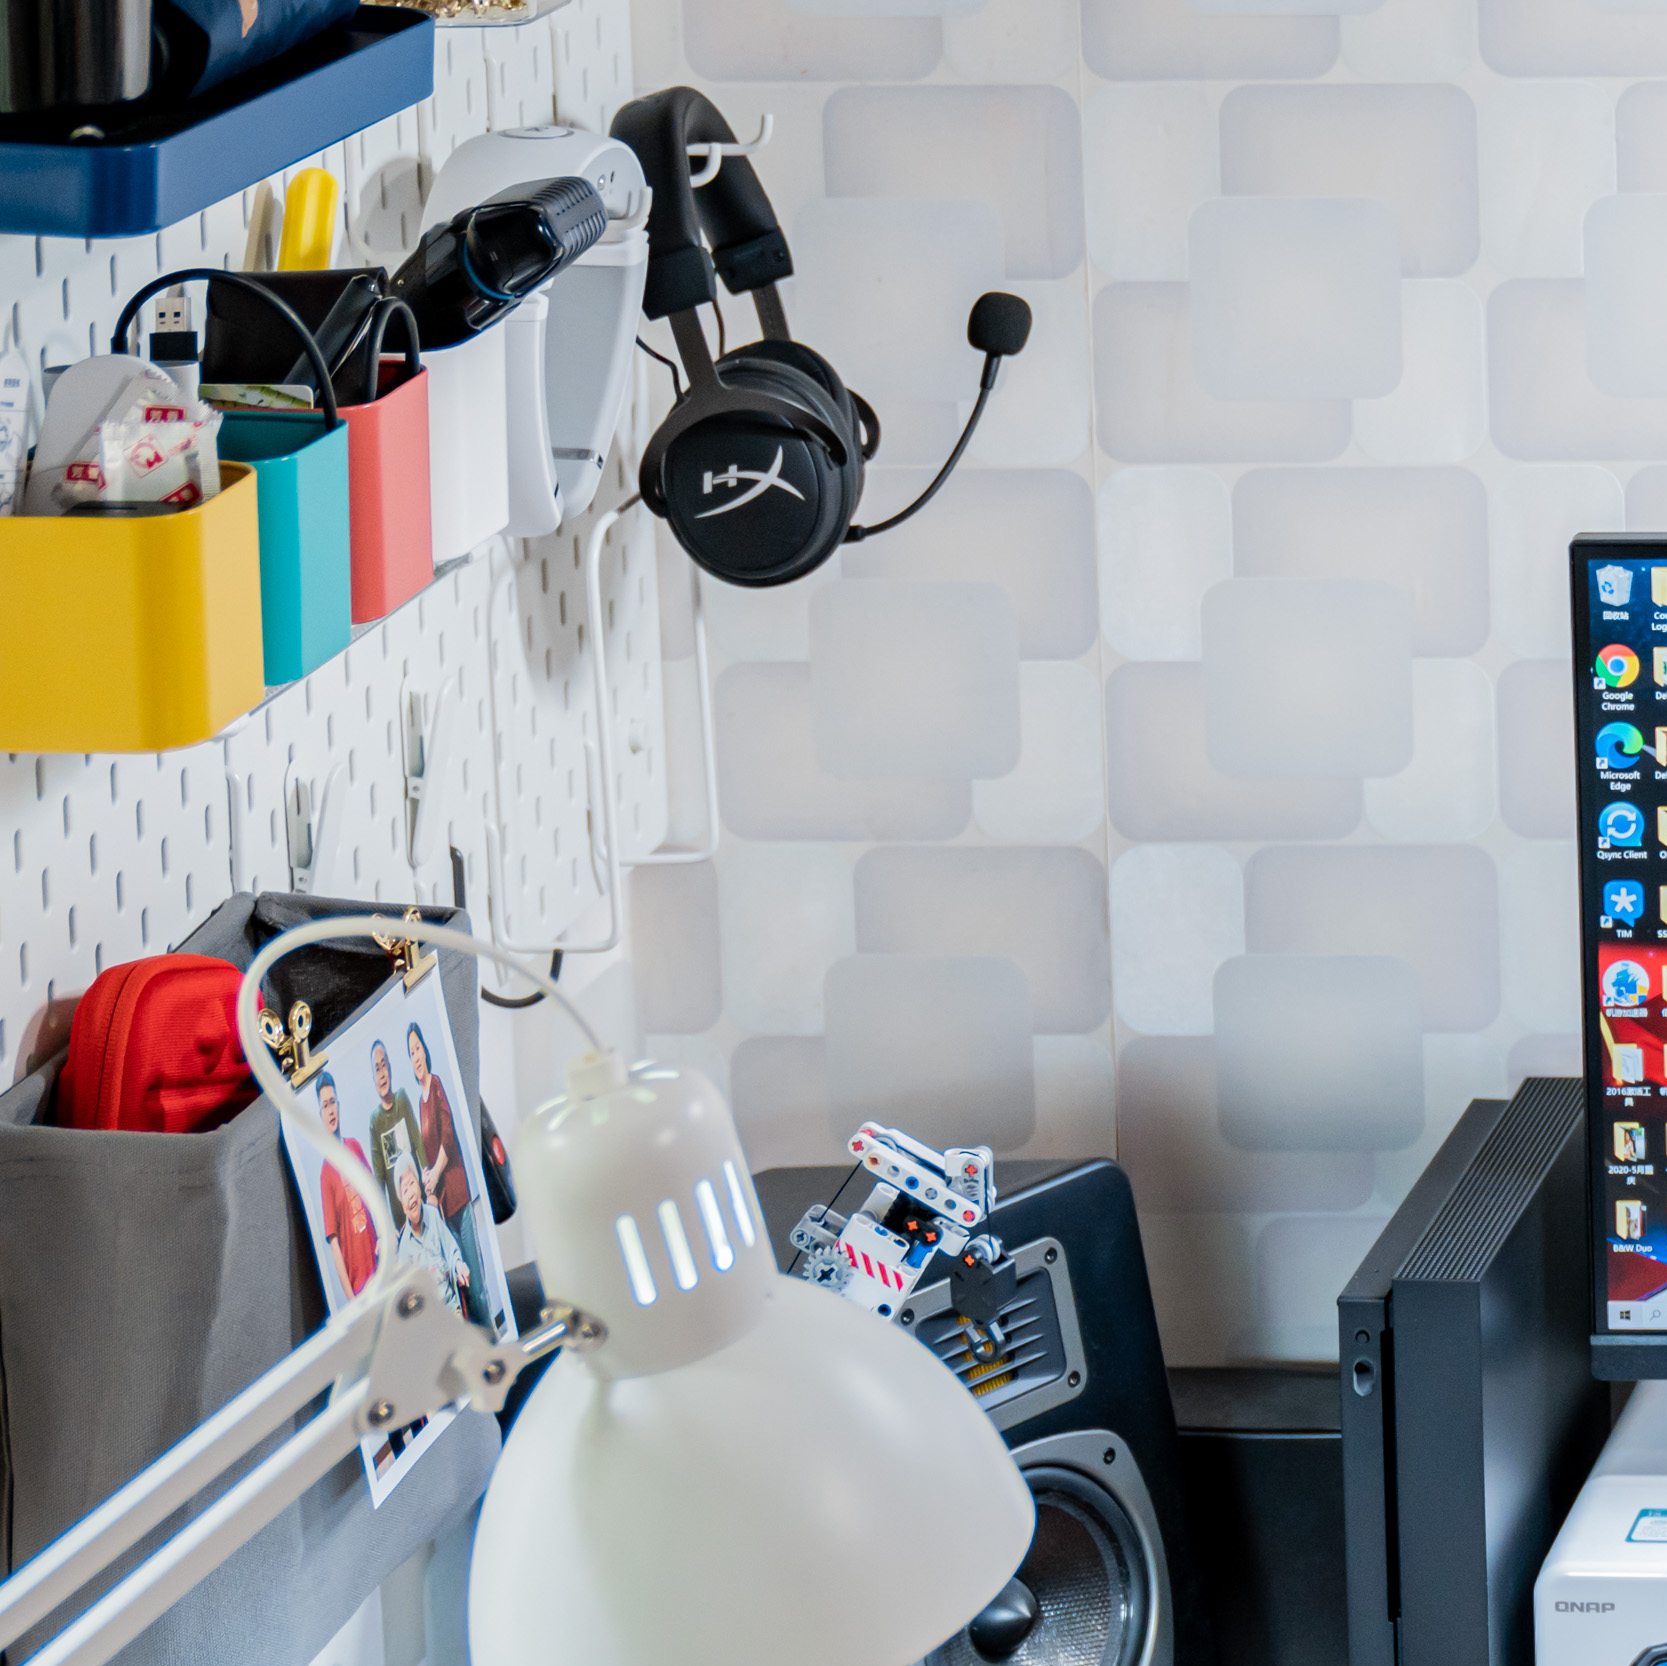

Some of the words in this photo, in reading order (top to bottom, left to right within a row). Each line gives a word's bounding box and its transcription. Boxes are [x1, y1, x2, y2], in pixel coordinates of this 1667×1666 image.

[1602, 611, 1630, 621] 回收站
[1602, 691, 1634, 702] Google
[1601, 702, 1635, 711] Chrome
[1600, 770, 1641, 780] Microsoft
[1609, 781, 1632, 792] Edge
[1597, 850, 1622, 861] Qsync
[1623, 850, 1648, 860] Client
[1615, 929, 1633, 939] TIM
[1612, 1243, 1635, 1253] B&W
[1636, 1243, 1653, 1253] Duo
[1554, 1601, 1616, 1614] QNAP
